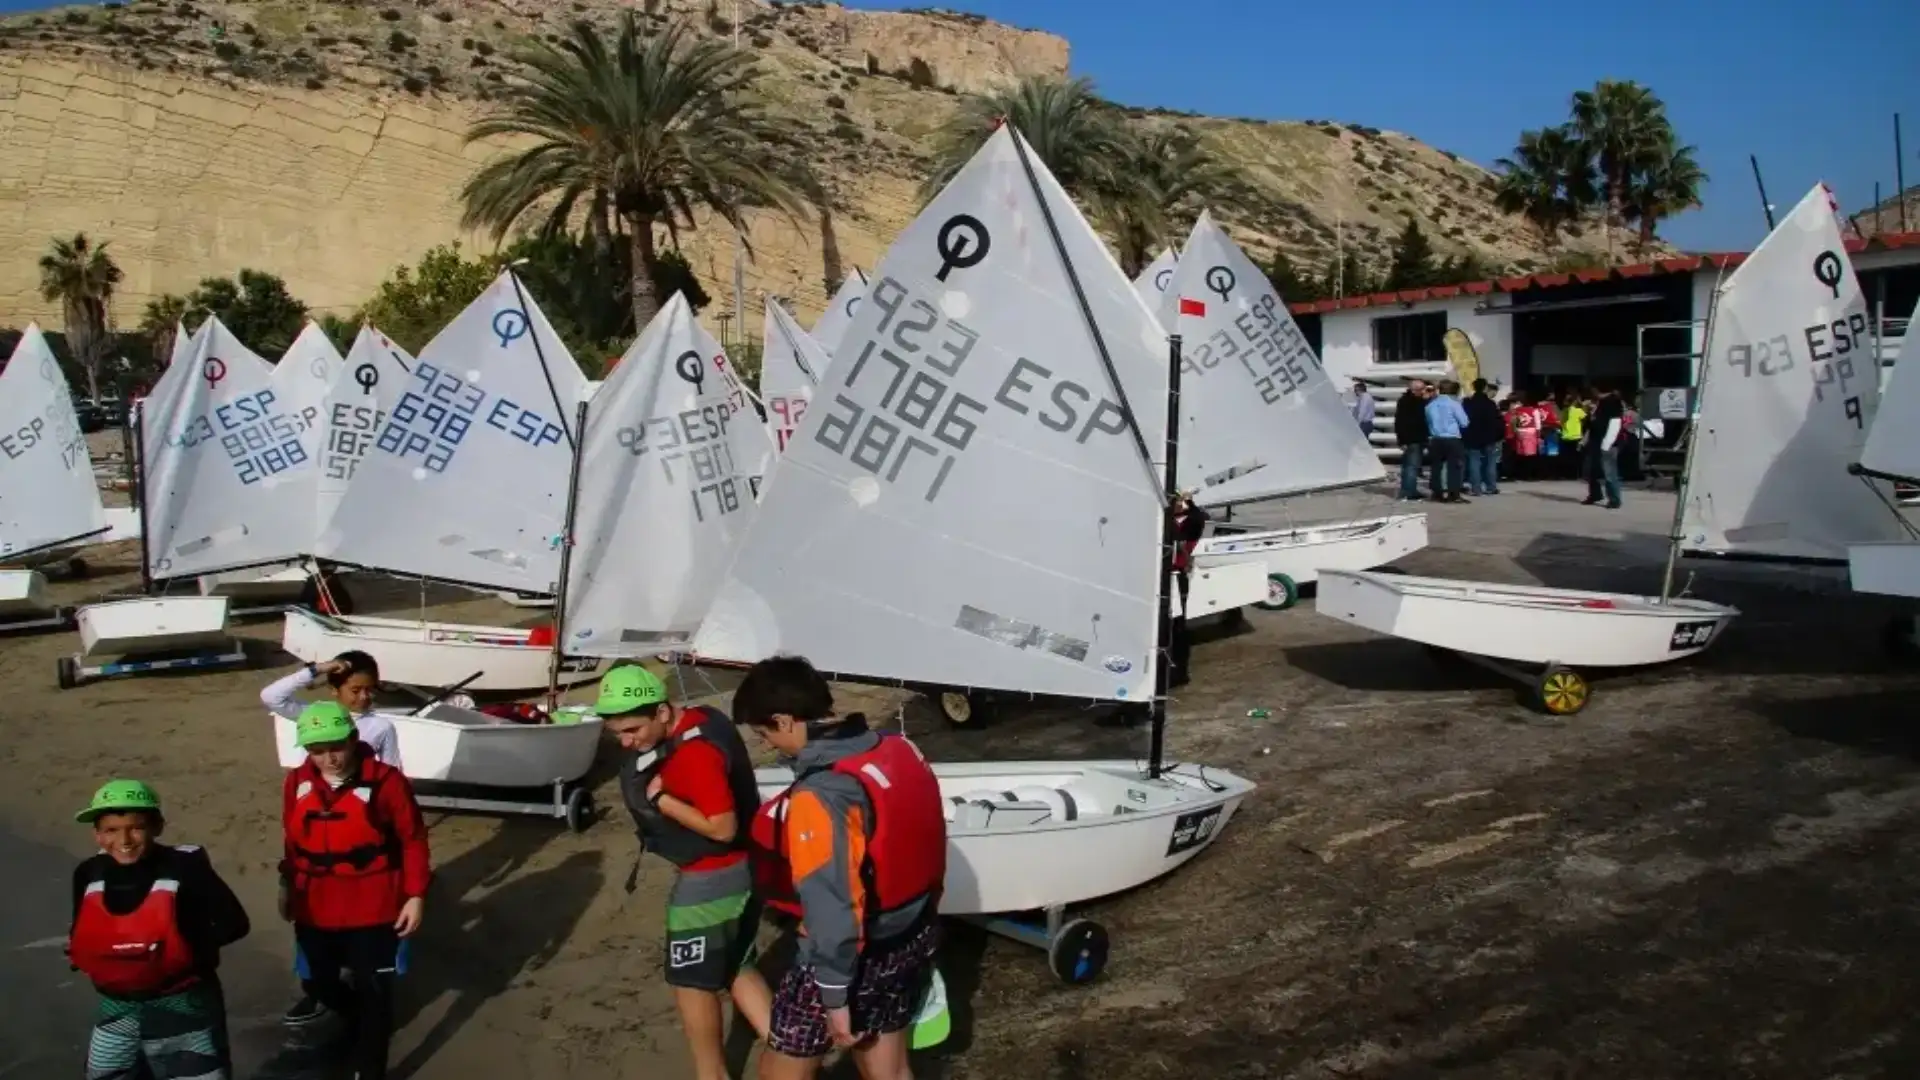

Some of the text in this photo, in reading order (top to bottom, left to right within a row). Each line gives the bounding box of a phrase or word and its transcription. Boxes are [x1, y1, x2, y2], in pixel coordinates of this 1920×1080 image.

[1235, 294, 1278, 341] ESP
[1805, 313, 1865, 361] ESP
[216, 390, 276, 430] ESP
[392, 391, 473, 446] 698
[845, 339, 988, 451] 1786
[995, 357, 1129, 444] ESP
[0, 417, 45, 460] ESP
[486, 398, 564, 447] ESP
[679, 404, 730, 445] ESP
[234, 439, 308, 485] 2188
[622, 687, 656, 698] 2015
